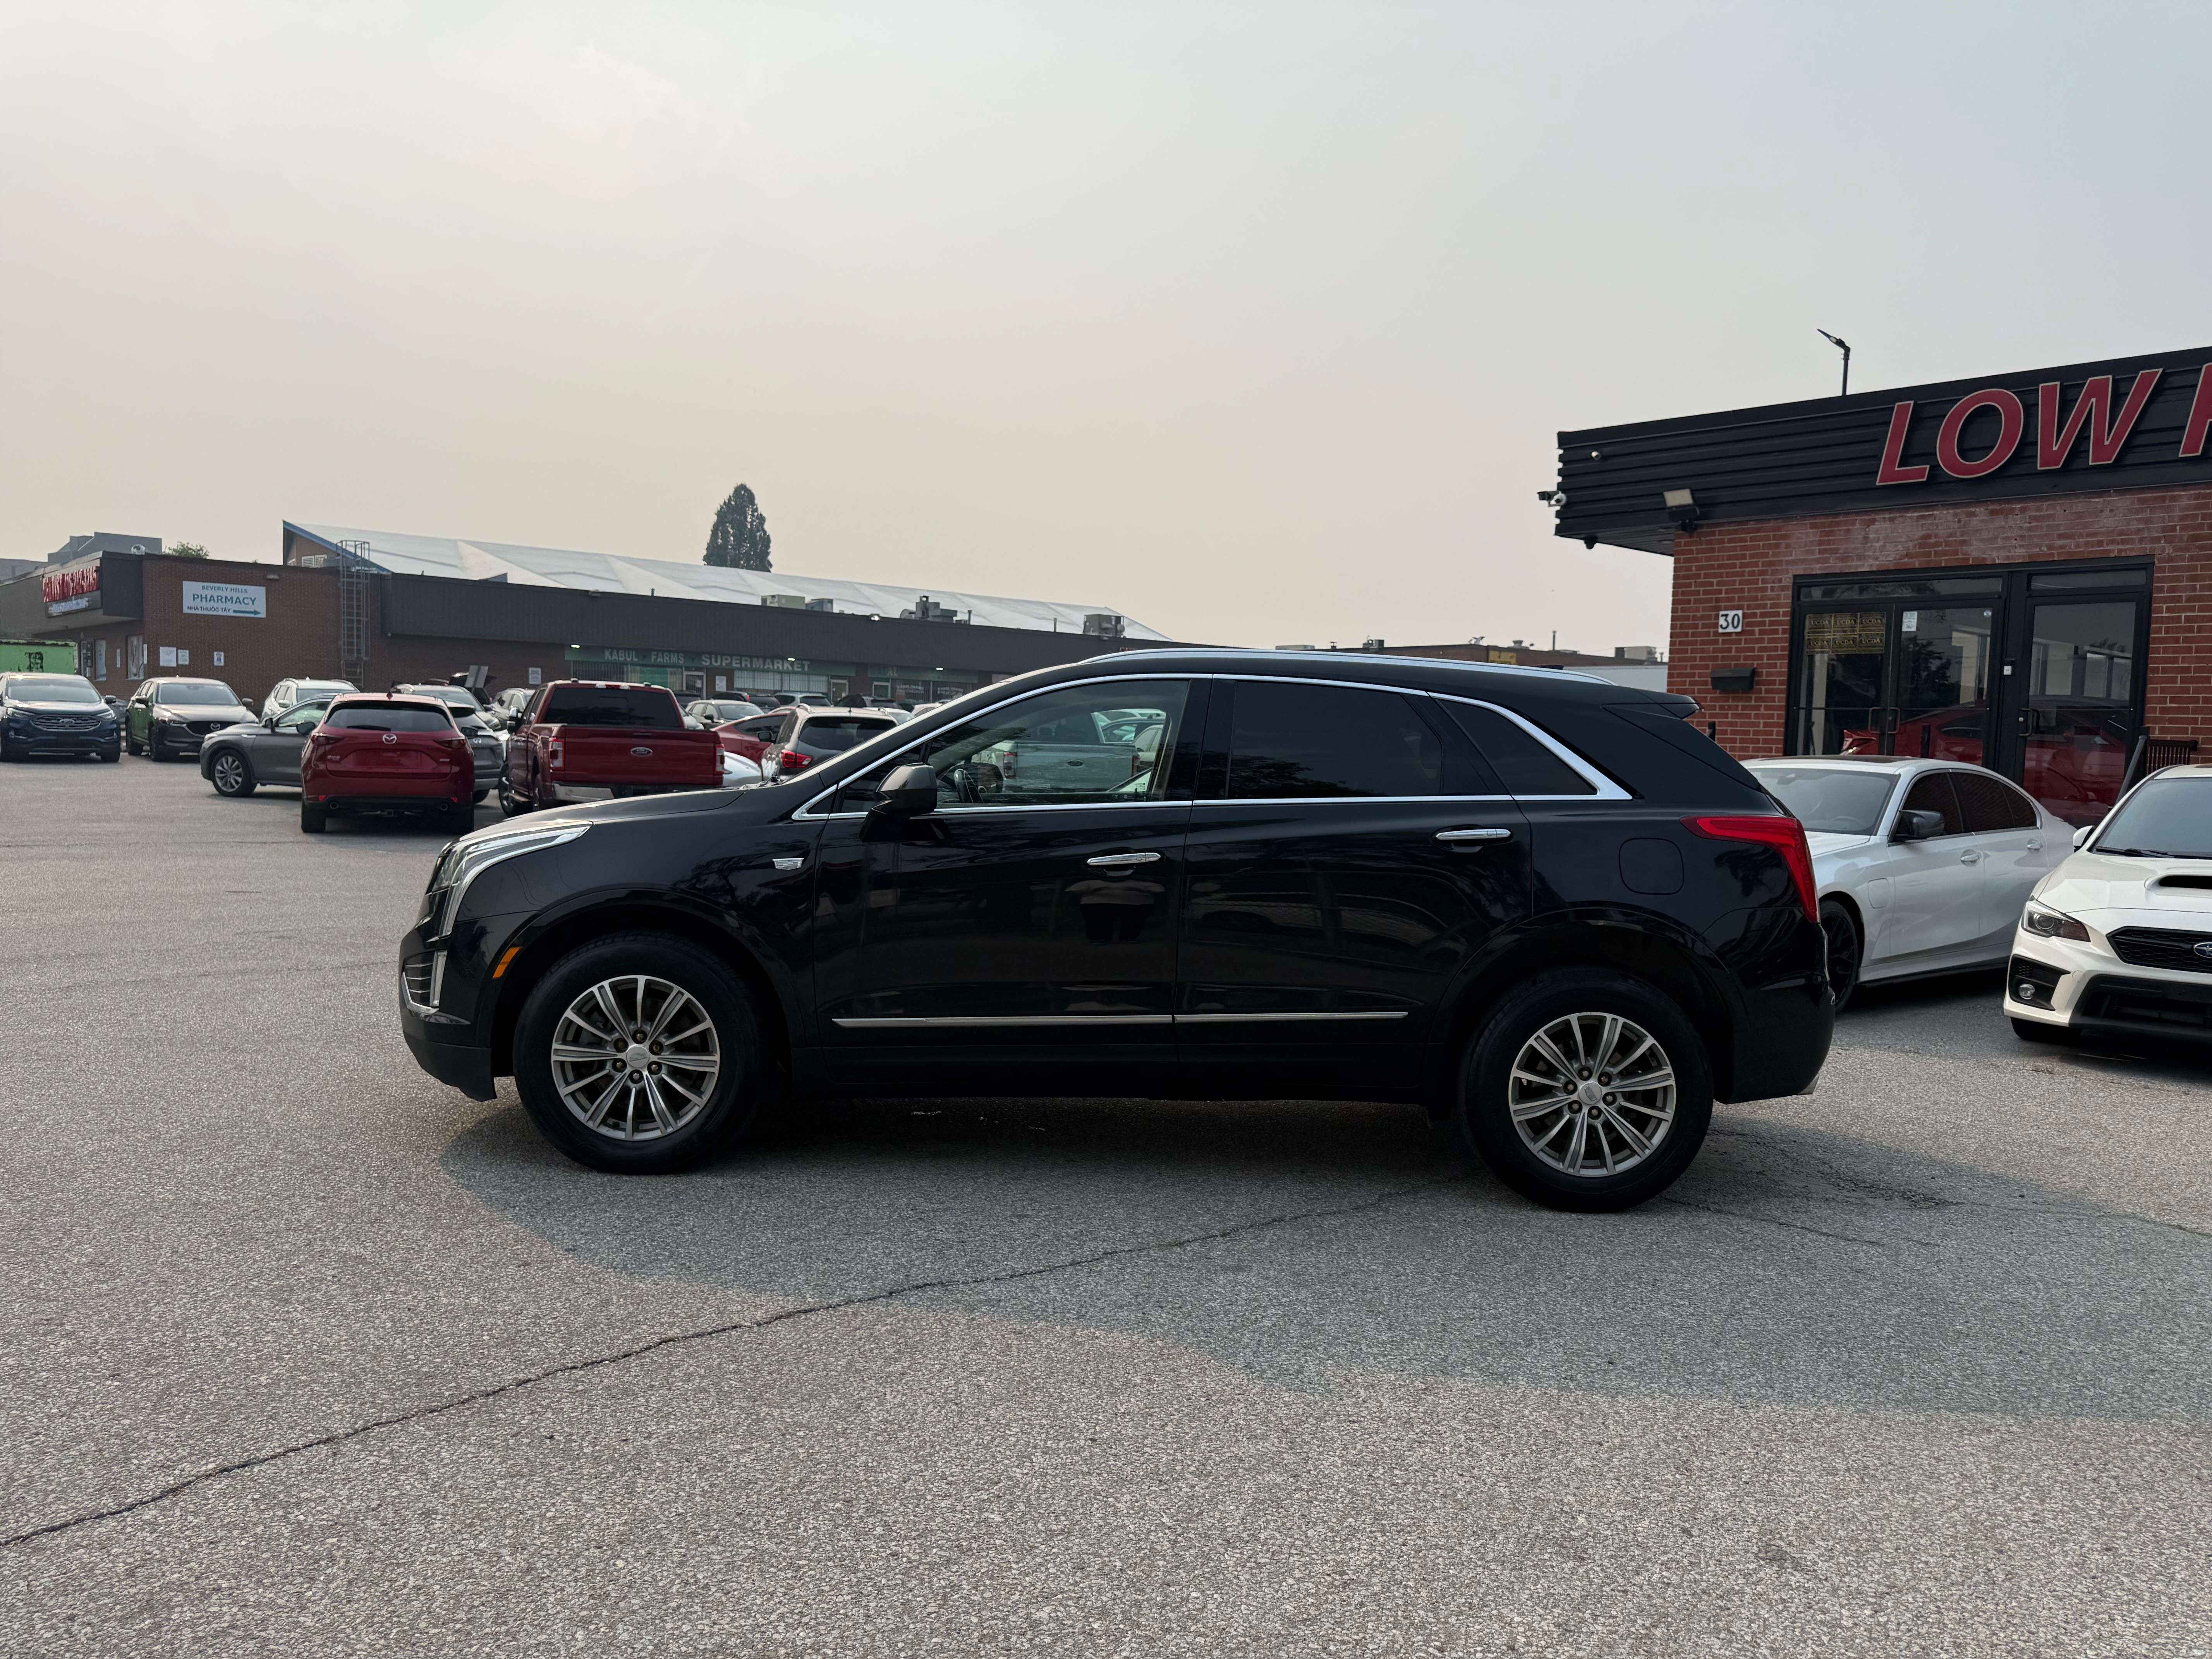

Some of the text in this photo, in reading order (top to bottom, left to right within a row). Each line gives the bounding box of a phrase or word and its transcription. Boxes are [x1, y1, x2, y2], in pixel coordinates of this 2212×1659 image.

[1876, 368, 2164, 485] LOW
[193, 593, 256, 605] PHARMACY
[1720, 613, 1740, 629] 30
[605, 649, 811, 671] KABUL FARMS SUPERMARKET
